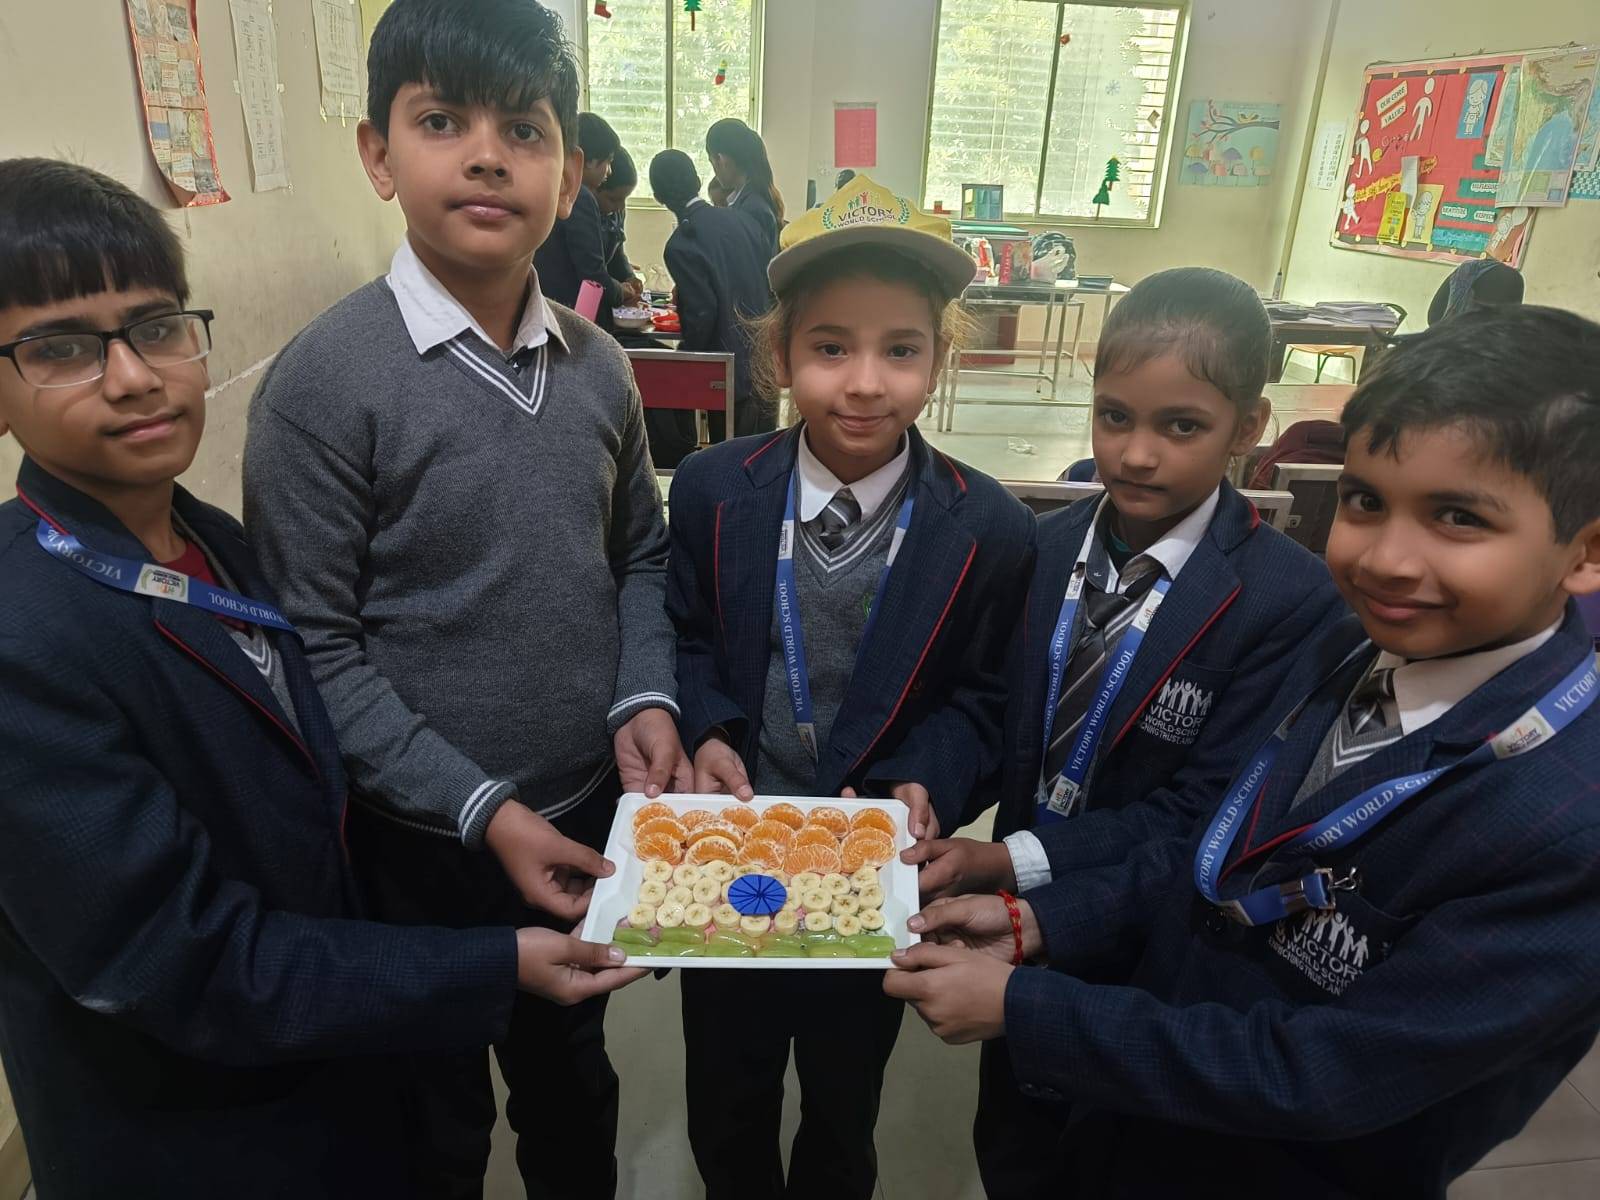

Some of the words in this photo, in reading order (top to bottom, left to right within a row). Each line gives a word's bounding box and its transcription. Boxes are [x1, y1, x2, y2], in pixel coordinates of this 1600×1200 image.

[838, 206, 894, 222] VICTORY
[838, 216, 865, 228] WORLD
[865, 214, 897, 223] SCHOOL
[51, 539, 121, 580] VICTORY
[152, 575, 180, 587] VICTORY
[208, 592, 249, 614] SCHOOL
[250, 606, 288, 624] WORLD
[779, 579, 792, 623] SCHOOL
[784, 625, 797, 665] WORLD
[1053, 619, 1069, 660] SCHOOL
[790, 667, 804, 712] VICTORY
[1049, 662, 1060, 701] WORLD
[1071, 727, 1094, 770] VICTORY
[1089, 690, 1110, 727] WORLD
[1106, 649, 1135, 691] SCHOOL
[1145, 714, 1175, 733] WORLD
[1150, 703, 1203, 729] VICTOR
[1208, 806, 1238, 850] WORLD
[1233, 759, 1268, 807] SCHOOL
[1342, 789, 1394, 829] WORLD
[1287, 940, 1320, 972] WORLD
[1292, 925, 1364, 981] VICTOR
